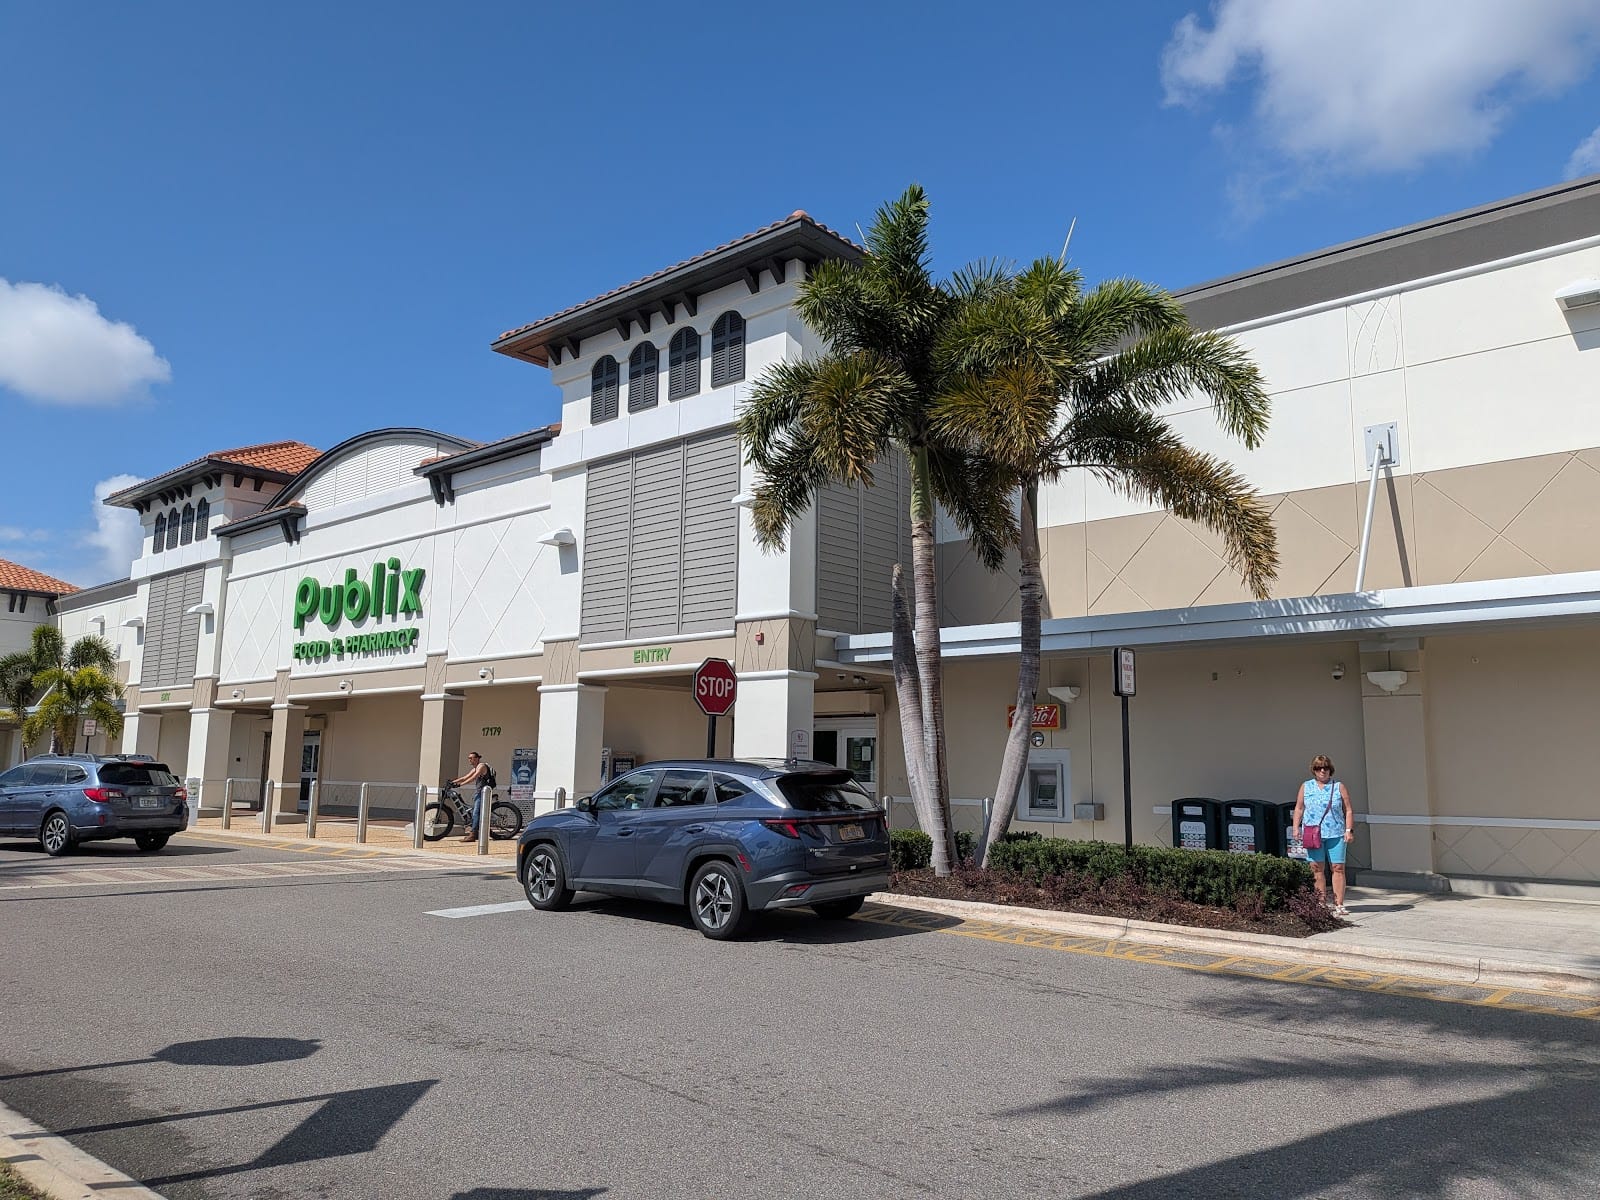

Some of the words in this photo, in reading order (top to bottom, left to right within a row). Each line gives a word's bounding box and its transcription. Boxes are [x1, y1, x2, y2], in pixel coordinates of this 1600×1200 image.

[294, 557, 425, 629] Publix
[293, 641, 330, 659] FOOD
[331, 638, 344, 655] &
[345, 628, 419, 653] PHARMACY
[633, 647, 672, 664] ENTRY
[698, 676, 734, 698] STOP
[482, 726, 502, 737] 17179
